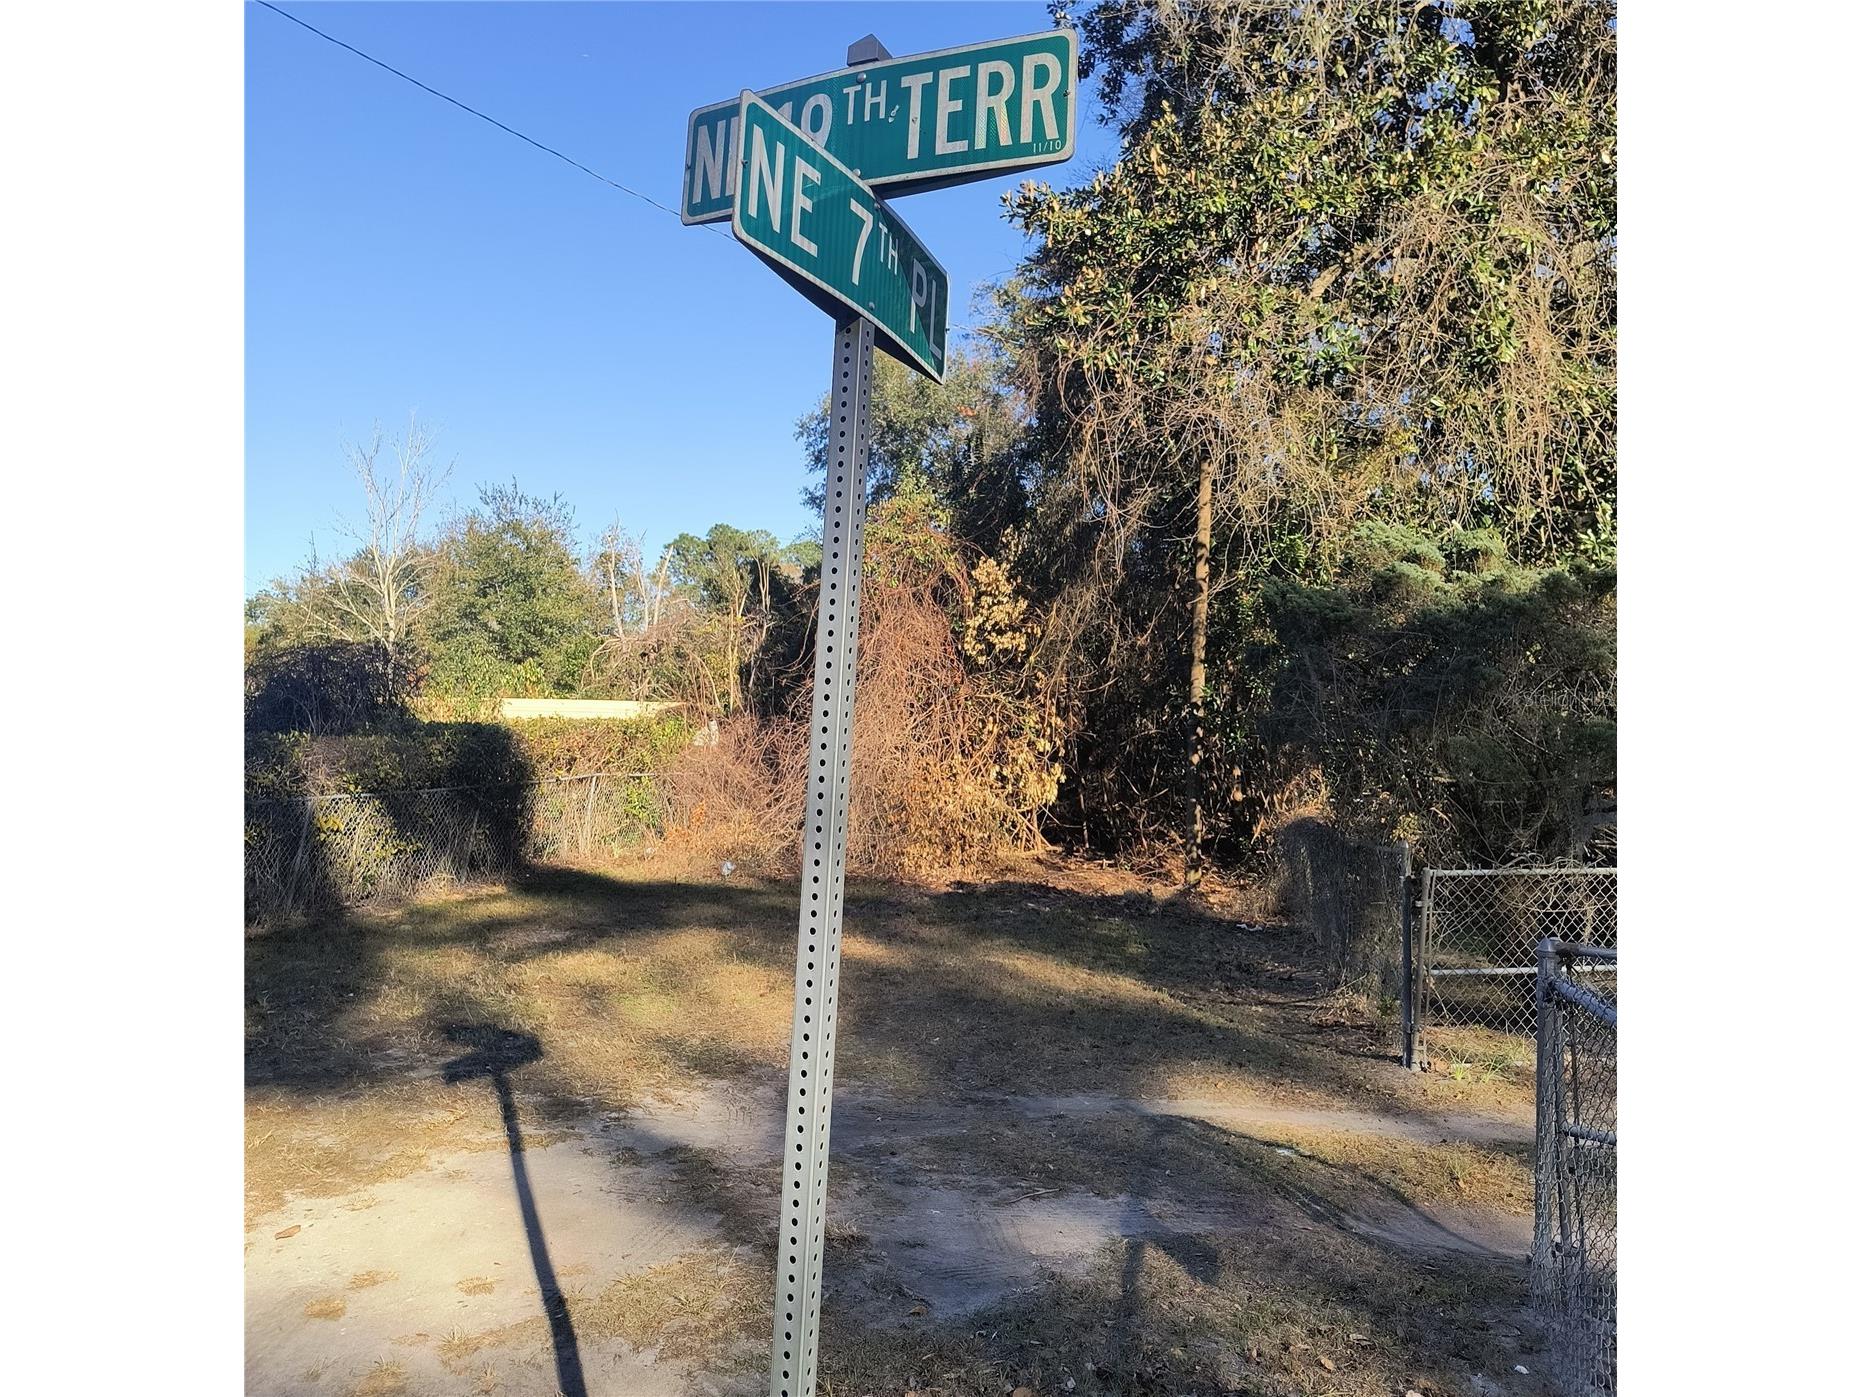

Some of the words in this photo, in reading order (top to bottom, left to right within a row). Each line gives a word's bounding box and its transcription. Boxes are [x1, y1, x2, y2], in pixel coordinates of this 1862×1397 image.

[900, 52, 1062, 160] TERR
[1033, 139, 1062, 153] 11/10
[748, 123, 821, 258] NE
[909, 257, 943, 360] PL
